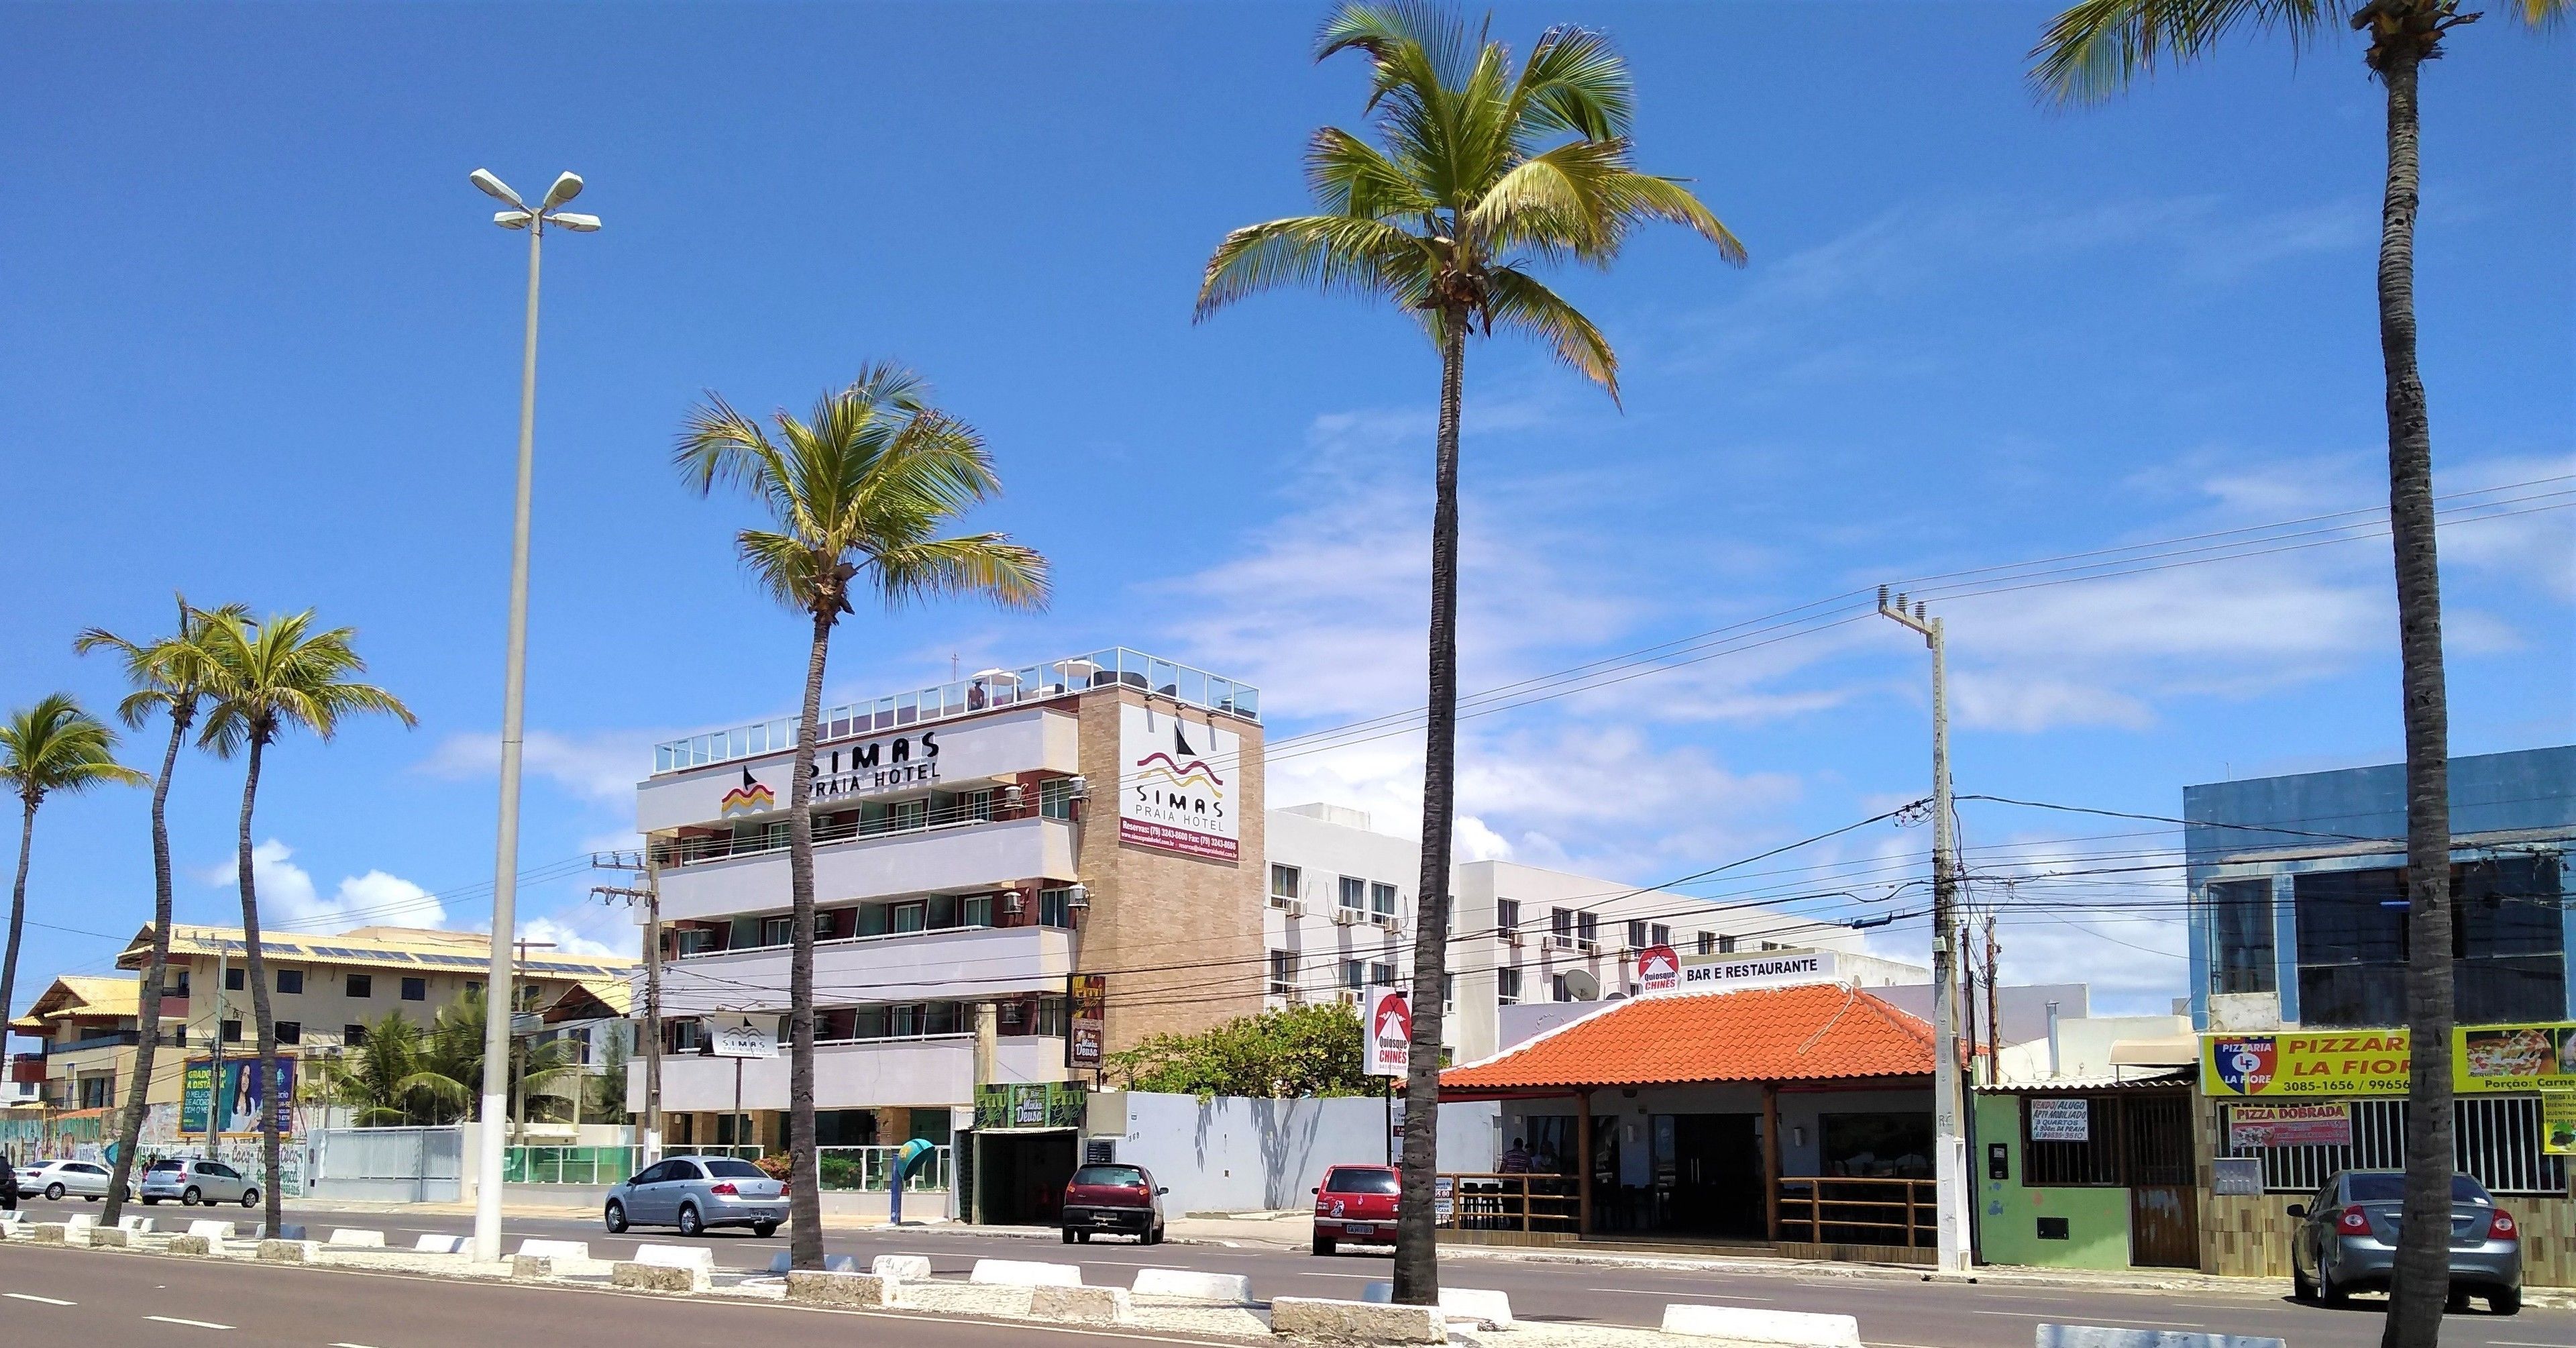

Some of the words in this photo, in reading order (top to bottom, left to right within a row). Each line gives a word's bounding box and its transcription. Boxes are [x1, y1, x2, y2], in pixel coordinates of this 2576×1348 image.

[809, 776, 860, 797] RAIA
[875, 762, 941, 787] HOTEL
[1136, 785, 1224, 818] SIMAS
[1136, 805, 1175, 821] PRAIA
[1183, 817, 1224, 832] HOTEL
[1123, 821, 1150, 833] Reservas:
[1150, 826, 1161, 837] (79)
[1189, 833, 1200, 843] Fax:
[1200, 835, 1210, 847] (79)
[1644, 972, 1676, 982] Quiosque
[1686, 969, 1711, 982] BAR
[1714, 967, 1722, 980] E
[1725, 958, 1818, 979] RESTAURANTE
[1645, 978, 1676, 991] CHINÊS
[722, 1039, 765, 1048] SIMAS
[1075, 1043, 1098, 1057] Deusa
[1379, 1035, 1407, 1050] Quiosque
[2222, 1042, 2272, 1053] PIZZARIA
[1379, 1049, 1407, 1064] CHINÊS
[2294, 1060, 2331, 1076] LA
[2341, 1059, 2410, 1075] FIOR
[2224, 1075, 2238, 1084] LA
[2241, 1074, 2272, 1084] FIORE
[2284, 1080, 2355, 1092] 3085-1656
[2369, 1079, 2410, 1090] 99656
[2485, 1079, 2532, 1090] Porção:
[2536, 1078, 2575, 1087] Carne
[1016, 1106, 1042, 1123] Deusa
[2237, 1109, 2275, 1121] PIZZA
[2279, 1106, 2345, 1119] DOBRADA
